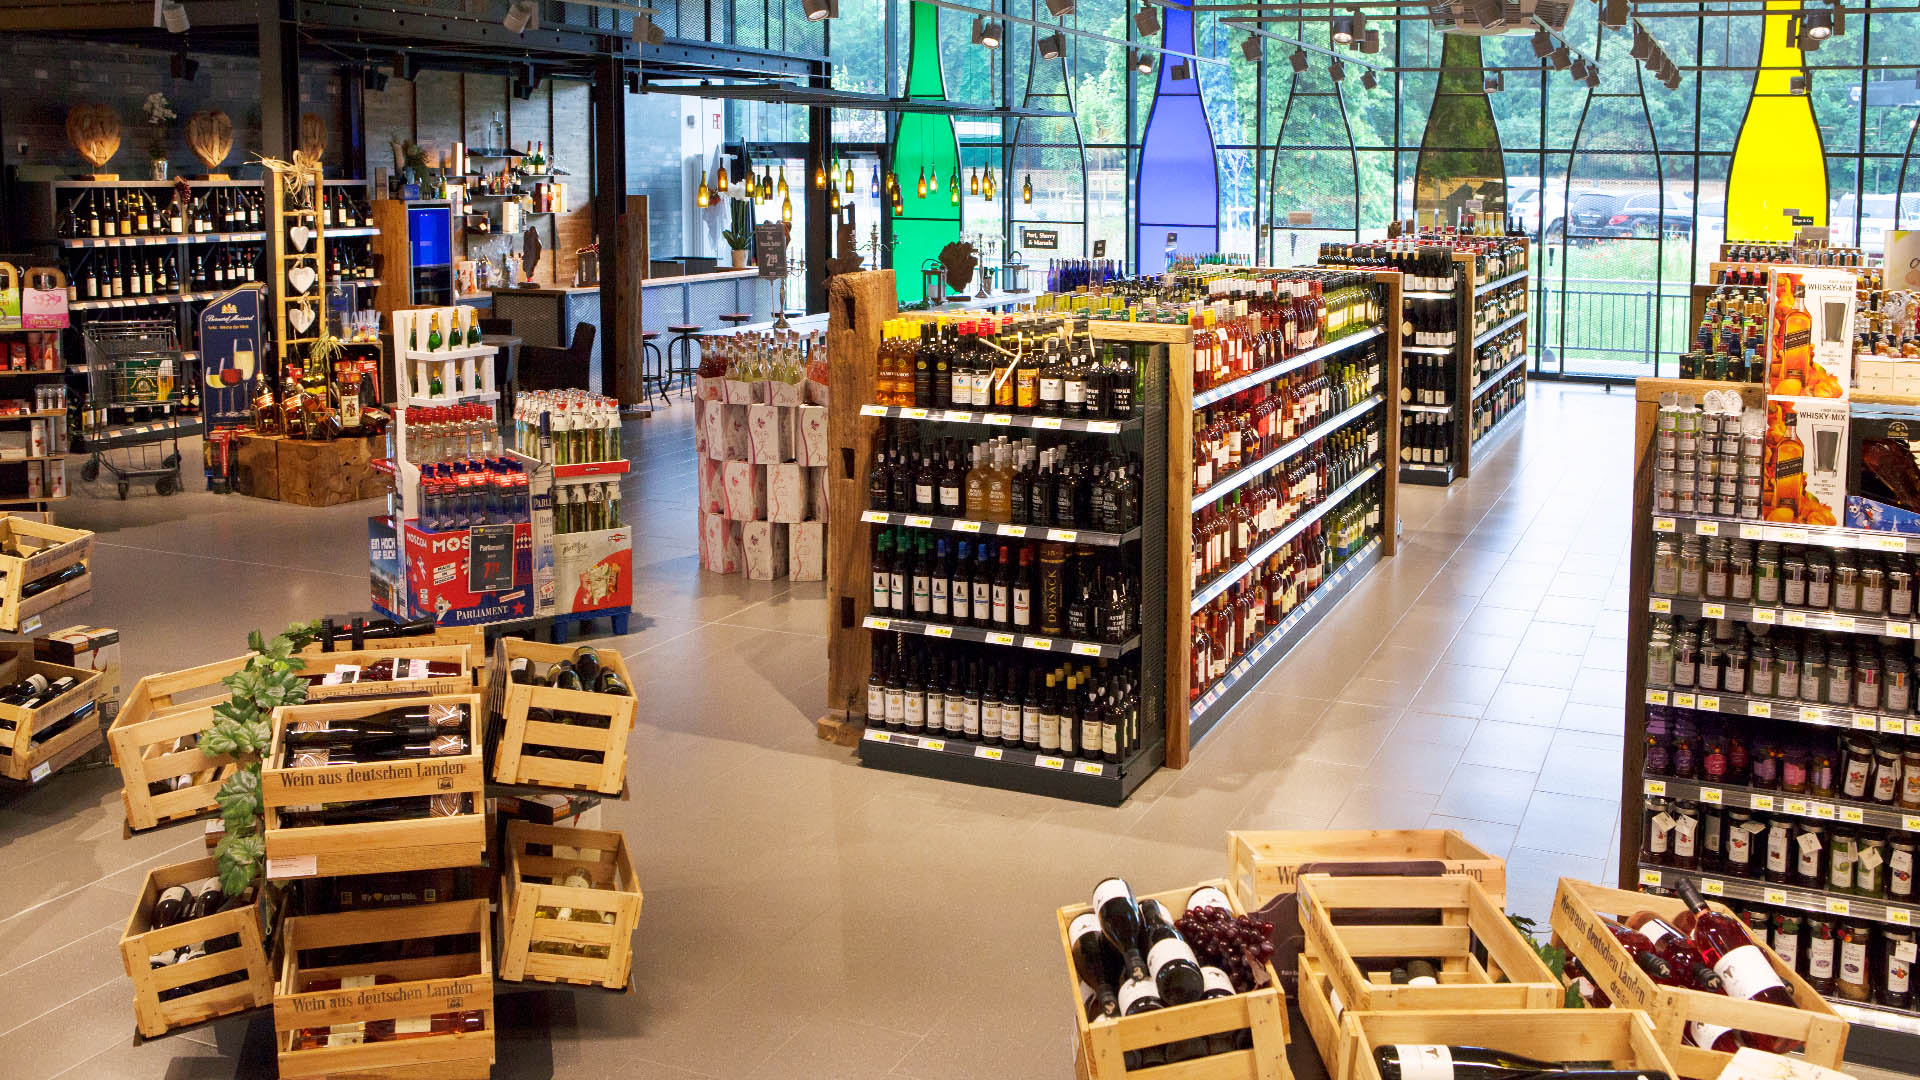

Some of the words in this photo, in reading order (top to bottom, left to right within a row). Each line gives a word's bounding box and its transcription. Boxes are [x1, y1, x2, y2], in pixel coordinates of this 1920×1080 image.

[1808, 283, 1853, 292] WHISKY-MIX
[1800, 411, 1846, 421] WHISKY-MIX
[381, 538, 395, 549] HOCH
[432, 536, 470, 553] MOS
[456, 605, 508, 621] PARLIAMENT
[411, 681, 454, 695] Landen
[280, 770, 315, 788] Wein
[318, 770, 342, 786] aus
[346, 764, 413, 783] deutschen
[416, 760, 465, 778] Landen
[1277, 865, 1299, 886] We
[1443, 864, 1482, 883] nden
[1561, 895, 1576, 921] Wein
[1575, 917, 1587, 935] aus
[1587, 923, 1619, 972] deutschen
[1618, 962, 1645, 1005] Landen
[292, 995, 326, 1014] Wein
[330, 994, 353, 1009] aus
[357, 986, 423, 1006] deutschen
[426, 981, 474, 999] Landen
